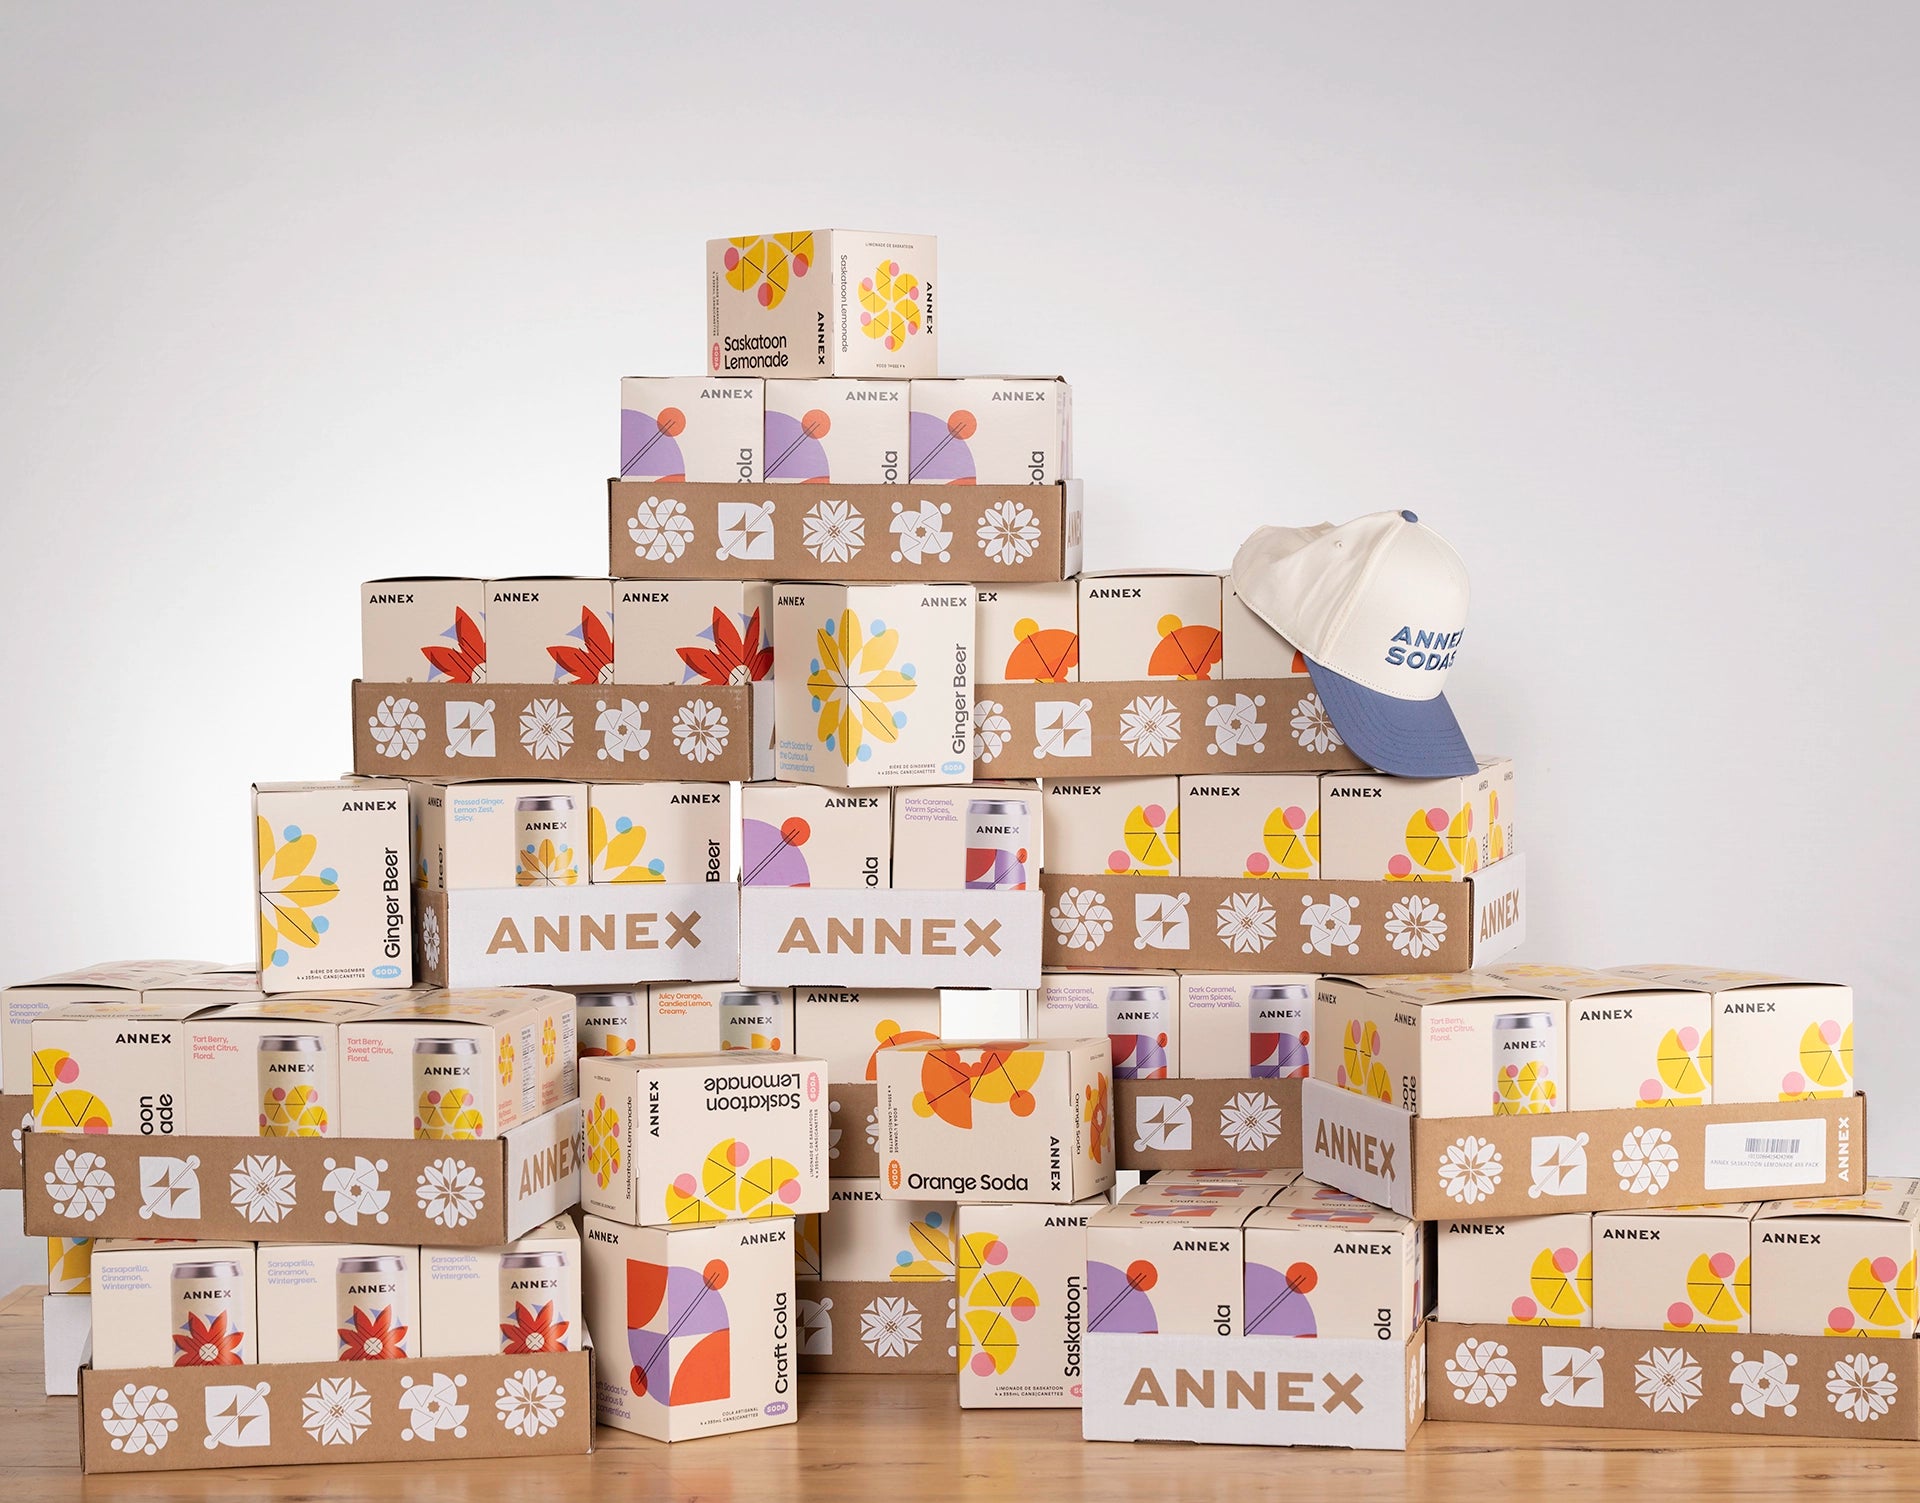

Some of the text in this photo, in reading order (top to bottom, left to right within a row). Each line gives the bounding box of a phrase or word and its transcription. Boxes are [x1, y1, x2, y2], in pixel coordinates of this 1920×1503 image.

[840, 254, 849, 353] Saskatoon Lemonade
[724, 334, 787, 352] Saskatoon
[724, 351, 789, 370] Lemonade
[700, 389, 753, 400] ANNEX
[846, 390, 899, 402] ANNEX
[992, 391, 1046, 402] ANNEX
[493, 592, 540, 602] ANNEX
[622, 592, 670, 602] ANNEX
[1089, 588, 1142, 598] ANNEX
[370, 594, 414, 604] ANNEX
[777, 596, 805, 606] ANNEX
[921, 597, 967, 607] ANNEX
[1384, 646, 1457, 671] SODAS
[952, 643, 969, 754] Ginger Beer
[1052, 786, 1101, 796] ANNEX
[1190, 786, 1240, 796] ANNEX
[1330, 788, 1382, 798] ANNEX
[428, 796, 442, 808] ANNEX
[454, 798, 504, 807] Pressed Ginger,
[670, 794, 721, 804] ANNEX
[824, 798, 879, 808] ANNEX
[922, 798, 954, 806] Caramel,
[342, 800, 397, 812] ANNEX
[476, 806, 495, 814] Zest,
[926, 806, 950, 815] Spices,
[454, 814, 474, 823] Spicy.
[904, 814, 959, 823] Creamy Vanilla.
[525, 822, 567, 831] ANNEX
[976, 825, 1020, 834] ANNEX
[706, 838, 721, 882] Beer
[862, 856, 879, 889] ola
[384, 847, 404, 959] Ginger Beer
[1479, 888, 1520, 943] ANNEX
[486, 910, 702, 955] ANNEX
[777, 917, 1002, 958] ANNEX
[375, 968, 398, 976] SODA
[1062, 987, 1094, 996] Caramel,
[1205, 986, 1237, 994] Caramel,
[676, 992, 704, 1001] Orange,
[806, 993, 860, 1003] ANNEX
[1068, 995, 1091, 1003] Spices,
[1210, 994, 1233, 1002] Spices,
[1317, 991, 1336, 1004] ANNEX
[9, 1002, 50, 1010] Sarsaparilla,
[658, 1000, 713, 1009] Candied Lemon,
[1046, 1003, 1073, 1011] Creamy
[1189, 1001, 1242, 1010] Creamy Vanilla.
[1724, 1002, 1776, 1014] ANNEX
[658, 1008, 688, 1016] Creamy.
[1117, 1011, 1159, 1020] ANNEX
[1259, 1010, 1301, 1018] ANNEX
[1580, 1009, 1633, 1021] ANNEX
[584, 1017, 628, 1026] ANNEX
[730, 1016, 773, 1025] ANNEX
[1394, 1012, 1416, 1027] ANNEX
[1445, 1018, 1465, 1027] Berry,
[1453, 1026, 1475, 1034] Citrus,
[116, 1034, 172, 1044] ANNEX
[208, 1036, 229, 1044] Berry,
[347, 1038, 384, 1047] Tart Berry,
[192, 1044, 240, 1052] Sweet Citrus,
[1503, 1040, 1546, 1050] ANNEX
[371, 1046, 394, 1055] Citrus,
[192, 1052, 216, 1060] Floral.
[268, 1064, 315, 1073] ANNEX
[424, 1067, 470, 1076] ANNEX
[704, 1073, 801, 1094] Lemonade
[706, 1093, 801, 1112] Saskatoon
[650, 1080, 659, 1137] ANNEX
[1315, 1118, 1396, 1182] ANNEX
[1838, 1116, 1850, 1182] ANNEX
[518, 1133, 581, 1201] ANNEX
[1050, 1136, 1061, 1191] ANNEX
[908, 1174, 1028, 1193] Orange Soda
[832, 1191, 883, 1201] ANNEX
[1449, 1224, 1505, 1235] ANNEX
[1603, 1229, 1660, 1240] ANNEX
[588, 1229, 619, 1244] ANNEX
[740, 1231, 786, 1246] ANNEX
[1762, 1233, 1821, 1244] ANNEX
[1173, 1241, 1230, 1252] ANNEX
[1333, 1244, 1392, 1255] ANNEX
[268, 1261, 315, 1269] Sarsaparilla,
[431, 1256, 478, 1264] Sarsaparilla,
[101, 1266, 150, 1274] Sarsaparilla,
[431, 1264, 472, 1272] Cinnamon,
[101, 1274, 143, 1282] Cinnamon,
[268, 1277, 318, 1285] Wintergreen.
[431, 1272, 480, 1281] Wintergreen.
[101, 1282, 152, 1291] Wintergreen.
[348, 1284, 396, 1294] ANNEX
[510, 1280, 558, 1289] ANNEX
[183, 1290, 231, 1300] ANNEX
[1064, 1276, 1080, 1377] Saskatoon
[773, 1292, 788, 1394] Craft Cola
[1123, 1367, 1364, 1415] ANNEX
[766, 1404, 786, 1413] SODA
